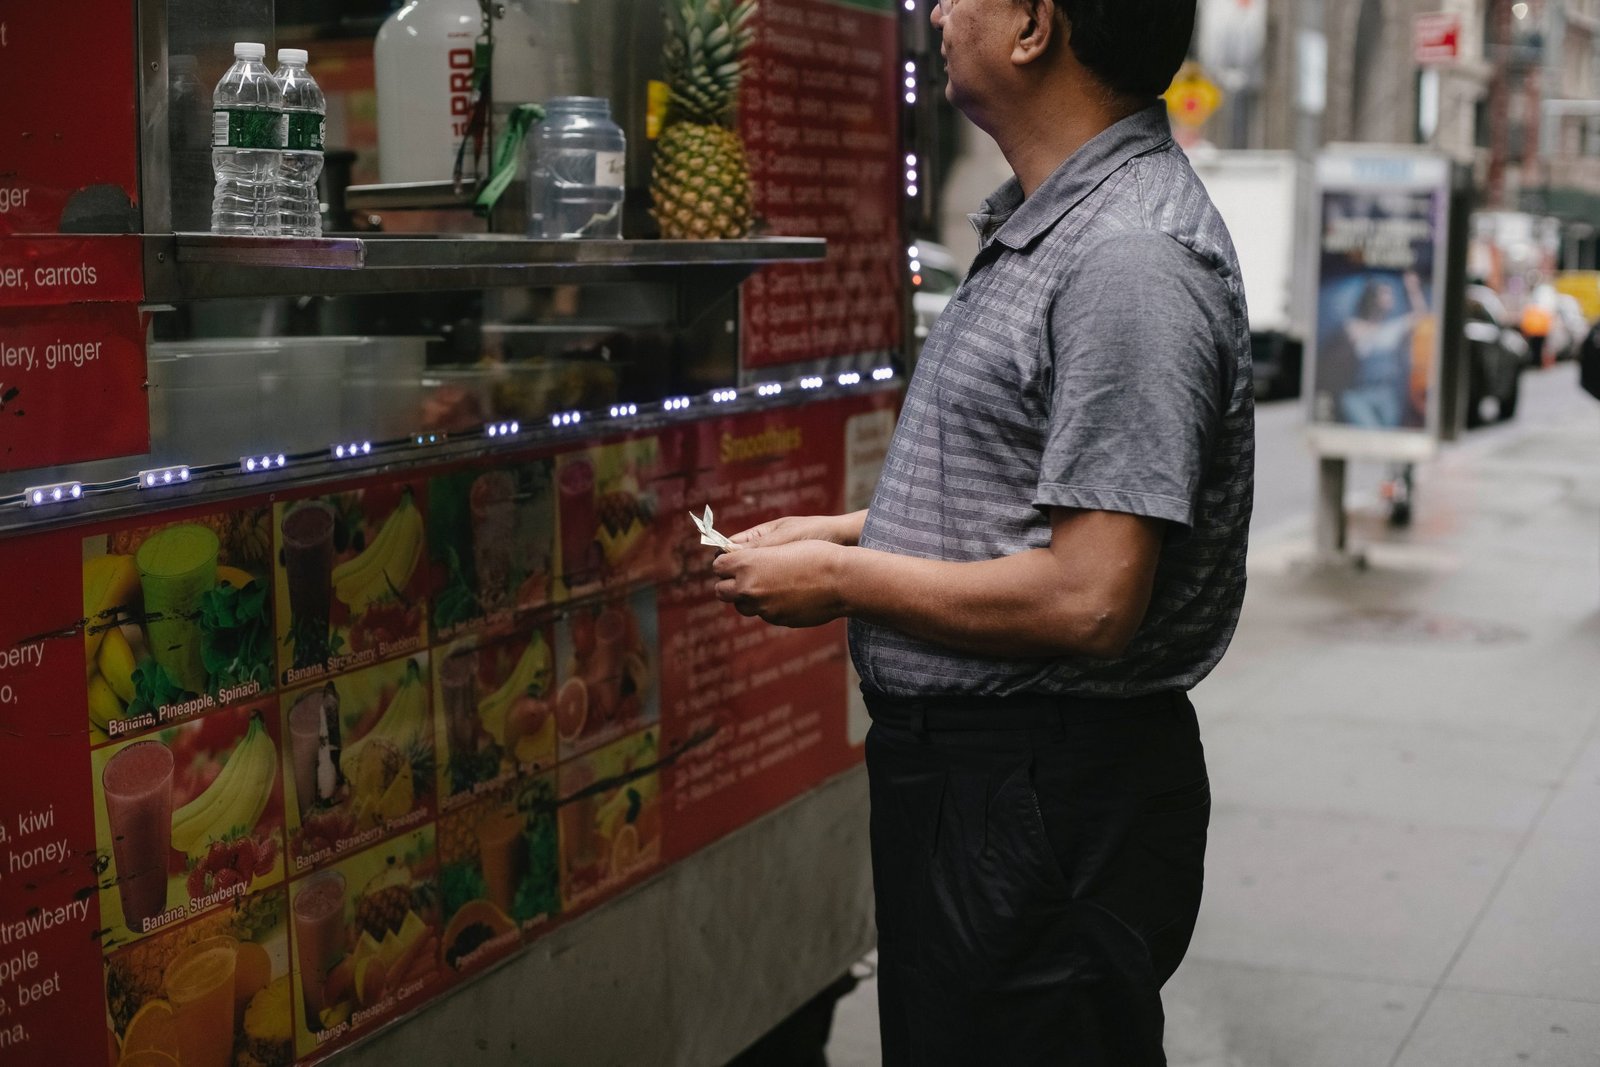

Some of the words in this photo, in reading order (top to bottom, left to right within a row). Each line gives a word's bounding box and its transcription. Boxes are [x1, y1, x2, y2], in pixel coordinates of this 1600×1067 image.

[449, 48, 475, 116] PRO
[34, 262, 98, 287] carrots
[45, 338, 102, 369] ginger
[108, 712, 157, 736] Banana,
[158, 693, 217, 721] Pineapple,
[218, 679, 261, 704] Spinach
[18, 804, 54, 837] kiwi
[9, 838, 71, 873] honey,
[0, 897, 90, 945] trawberry
[142, 905, 188, 932] Banana,
[190, 880, 248, 912] Strawberry
[18, 970, 61, 1006] beet
